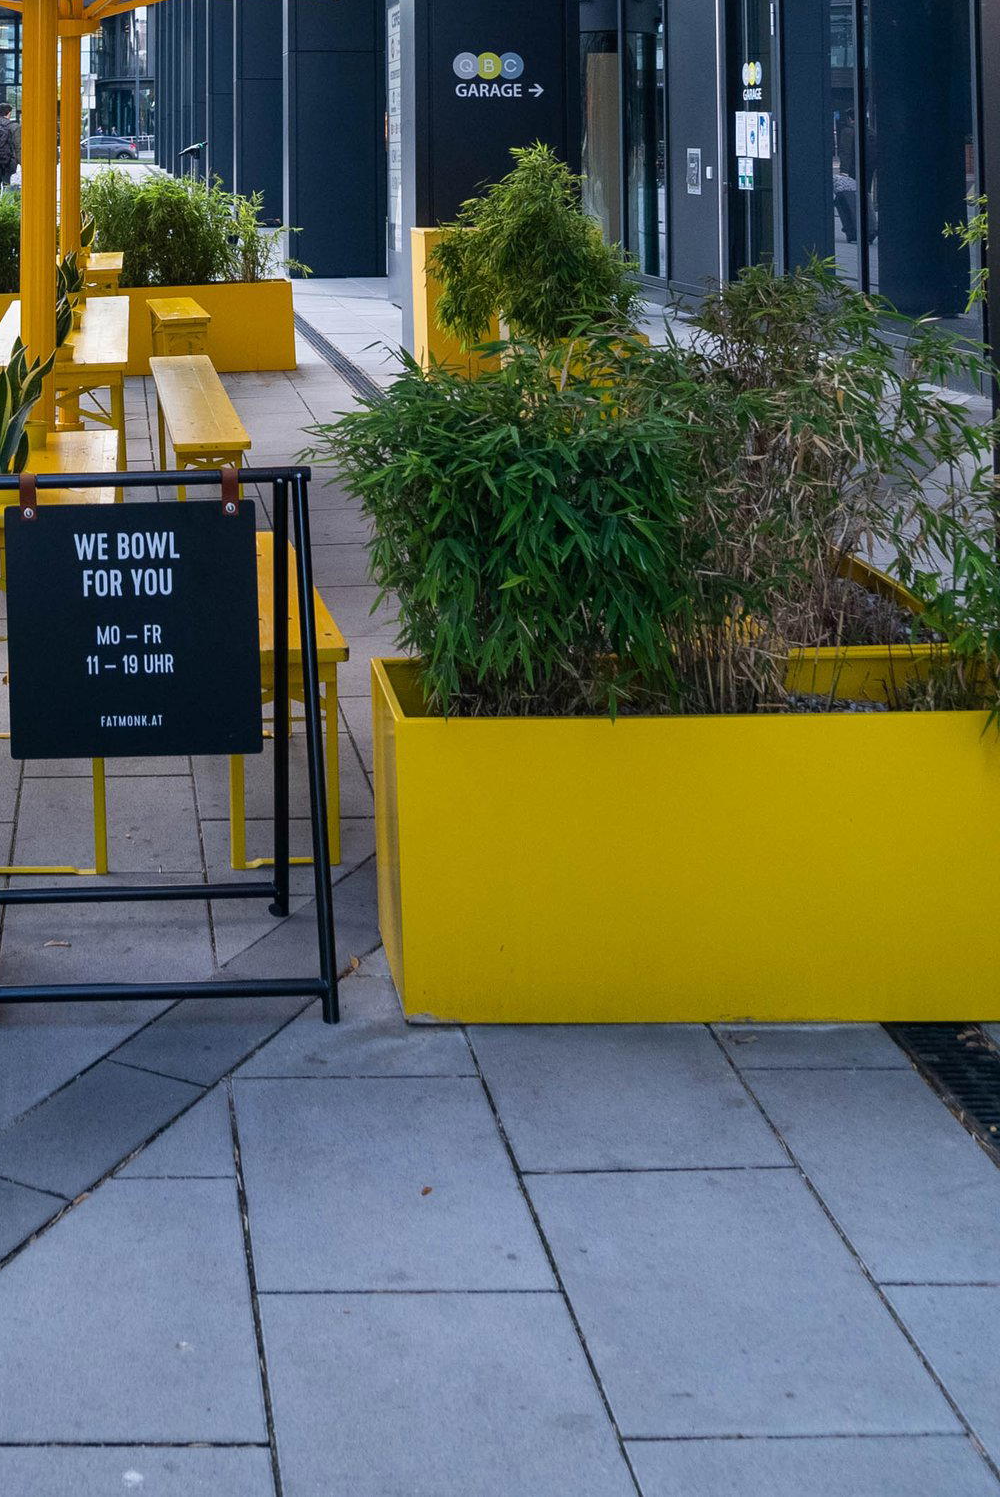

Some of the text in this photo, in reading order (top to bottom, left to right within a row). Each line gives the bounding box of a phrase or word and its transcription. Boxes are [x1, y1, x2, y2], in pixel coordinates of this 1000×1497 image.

[459, 58, 518, 73] QBC
[455, 83, 522, 97] GARAGE
[742, 87, 762, 101] GARAGE
[73, 531, 180, 561] WE BOWL
[82, 567, 173, 597] FOR YOU
[96, 625, 121, 645] MO
[143, 624, 162, 644] FR
[86, 655, 99, 675] 11
[122, 655, 138, 674] 19
[143, 654, 174, 674] UHR
[100, 714, 163, 727] FATMONK.AT
